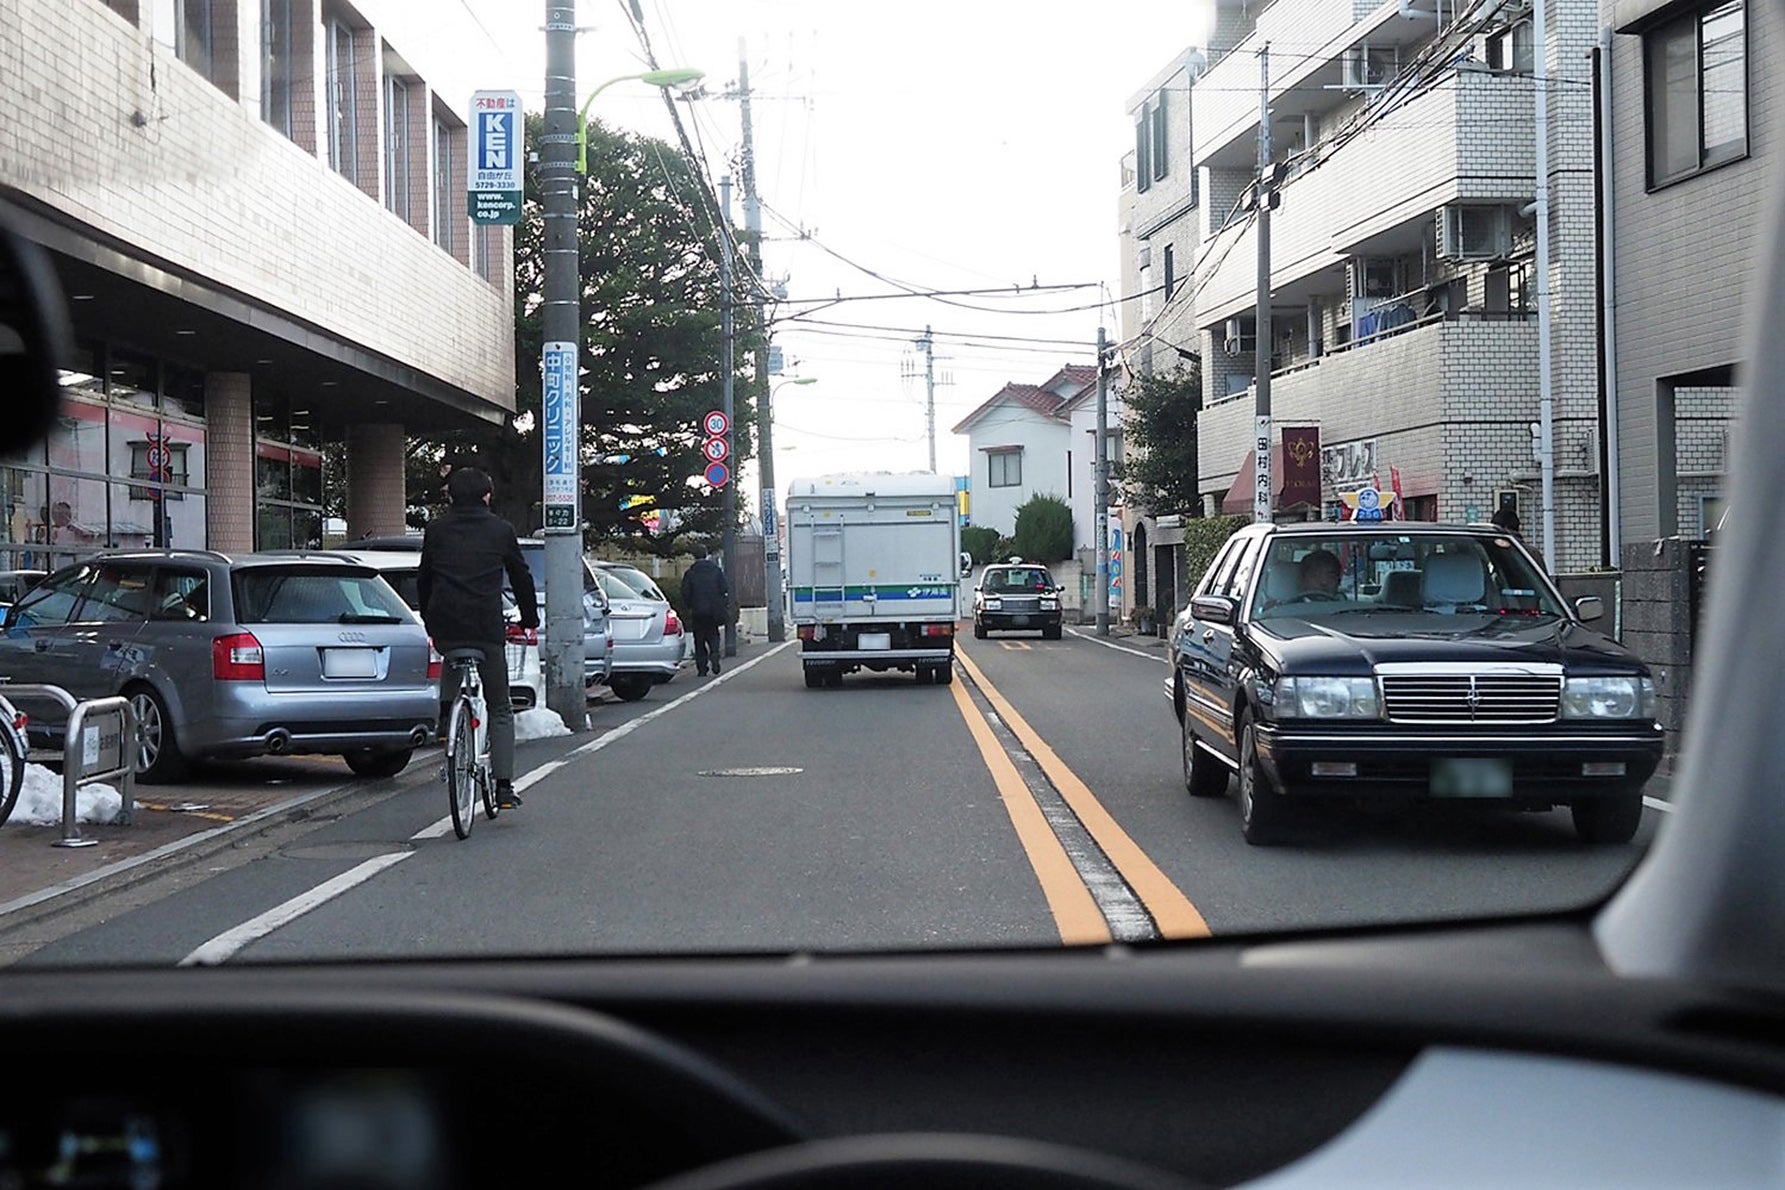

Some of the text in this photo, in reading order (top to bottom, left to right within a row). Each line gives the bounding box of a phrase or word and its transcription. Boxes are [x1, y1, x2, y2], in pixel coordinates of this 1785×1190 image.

[476, 98, 515, 109] 不動産は
[486, 114, 506, 168] KEN
[477, 201, 516, 210] kencorp.
[477, 210, 500, 218] co.jp
[546, 354, 561, 472] 中町クリニック
[710, 418, 724, 430] 30
[1257, 437, 1268, 505] 田村内科
